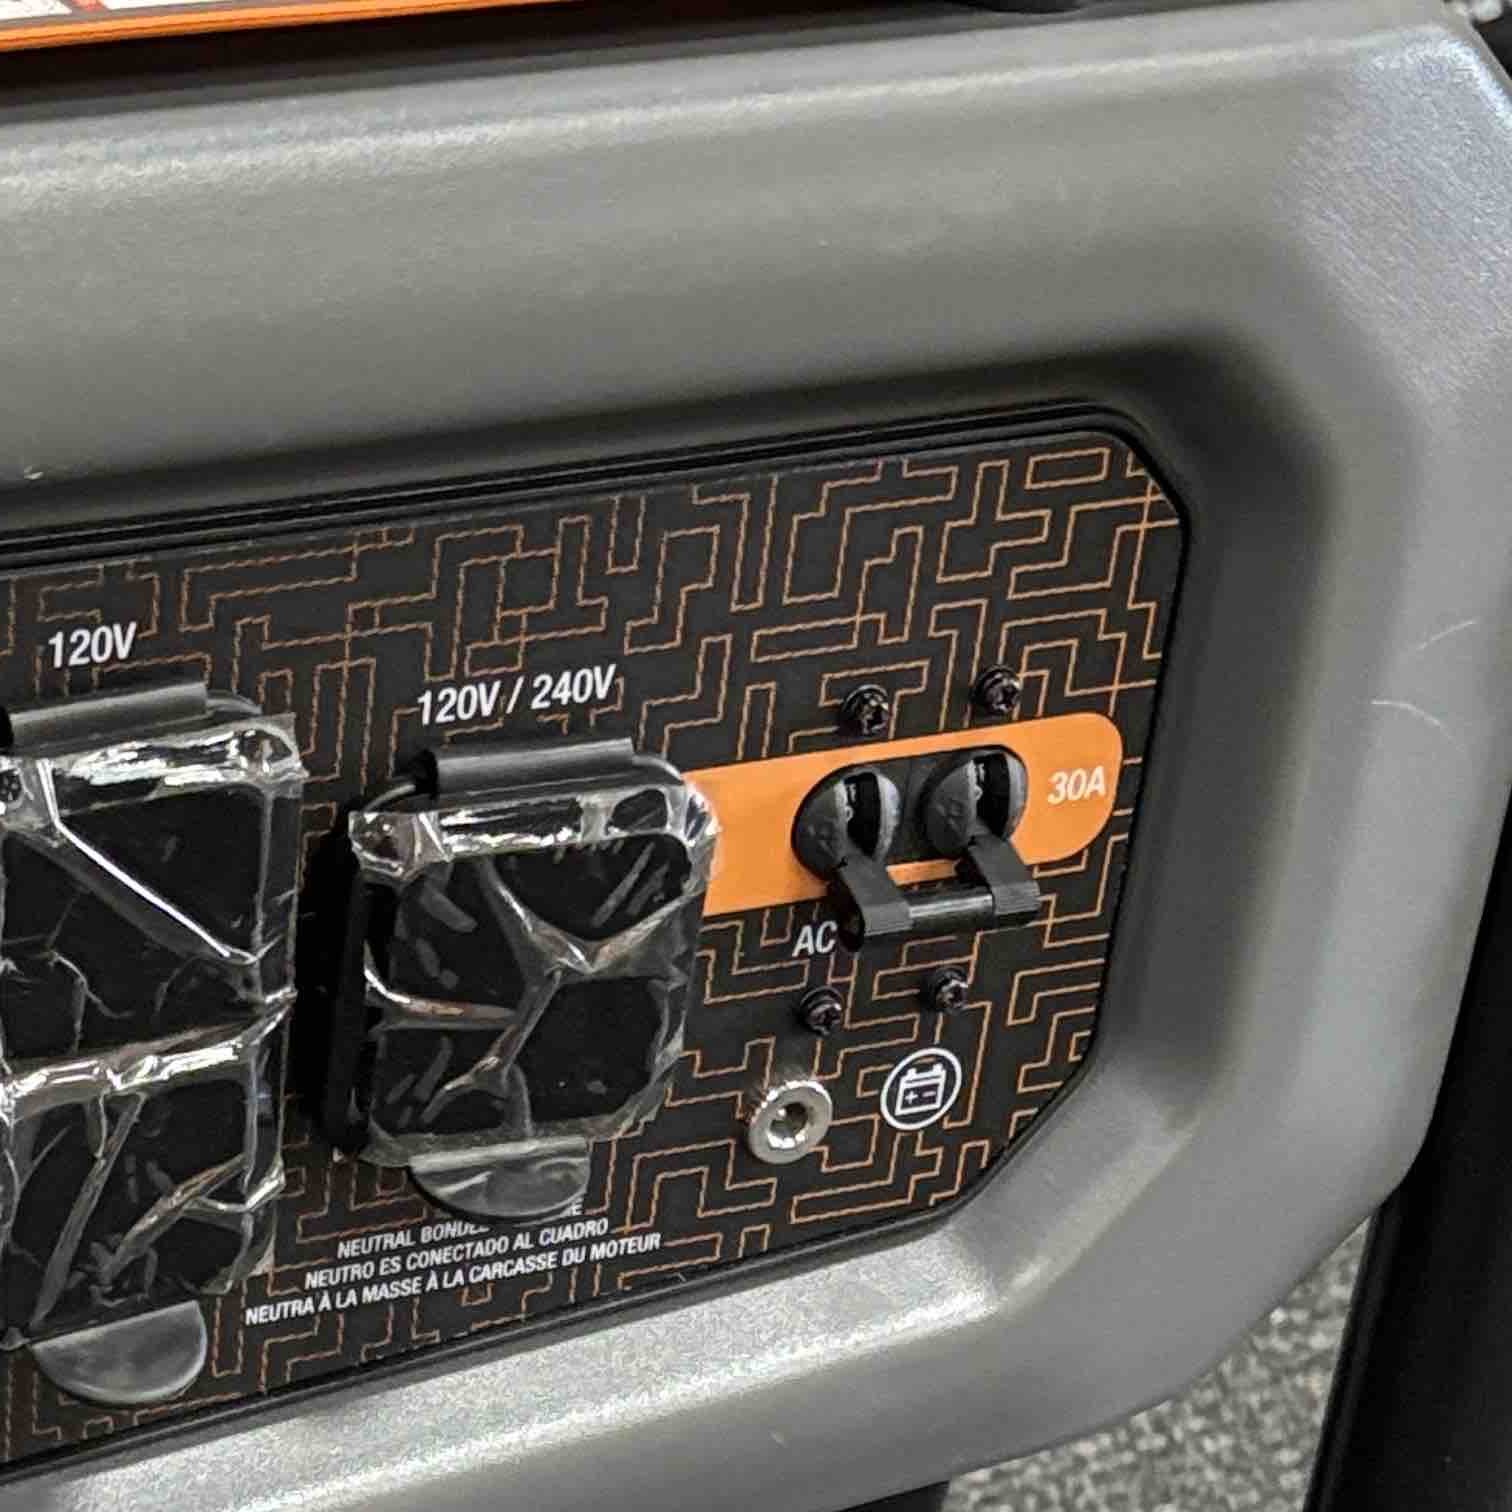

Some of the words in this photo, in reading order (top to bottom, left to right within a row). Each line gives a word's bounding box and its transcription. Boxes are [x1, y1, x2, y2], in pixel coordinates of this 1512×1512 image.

[47, 622, 138, 669] 120V
[418, 681, 503, 727] 120V
[532, 664, 617, 710] 240V
[1047, 765, 1106, 805] 30A
[792, 920, 838, 959] AC
[304, 1262, 375, 1290] NEUTRO
[379, 1257, 402, 1276] ES
[405, 1237, 510, 1271] CONECTADO
[513, 1232, 537, 1252] AL
[538, 1217, 609, 1246] CUADRO
[337, 1231, 416, 1259] NEUTRAL
[245, 1298, 315, 1326] NEUTRA
[317, 1290, 332, 1312] À
[335, 1288, 358, 1308] LA
[361, 1278, 423, 1304] MASSE
[425, 1268, 439, 1290] À
[442, 1268, 466, 1289] LA
[468, 1250, 558, 1282] CARCASSE
[561, 1245, 586, 1266] DU
[589, 1232, 662, 1260] MOTEUR
